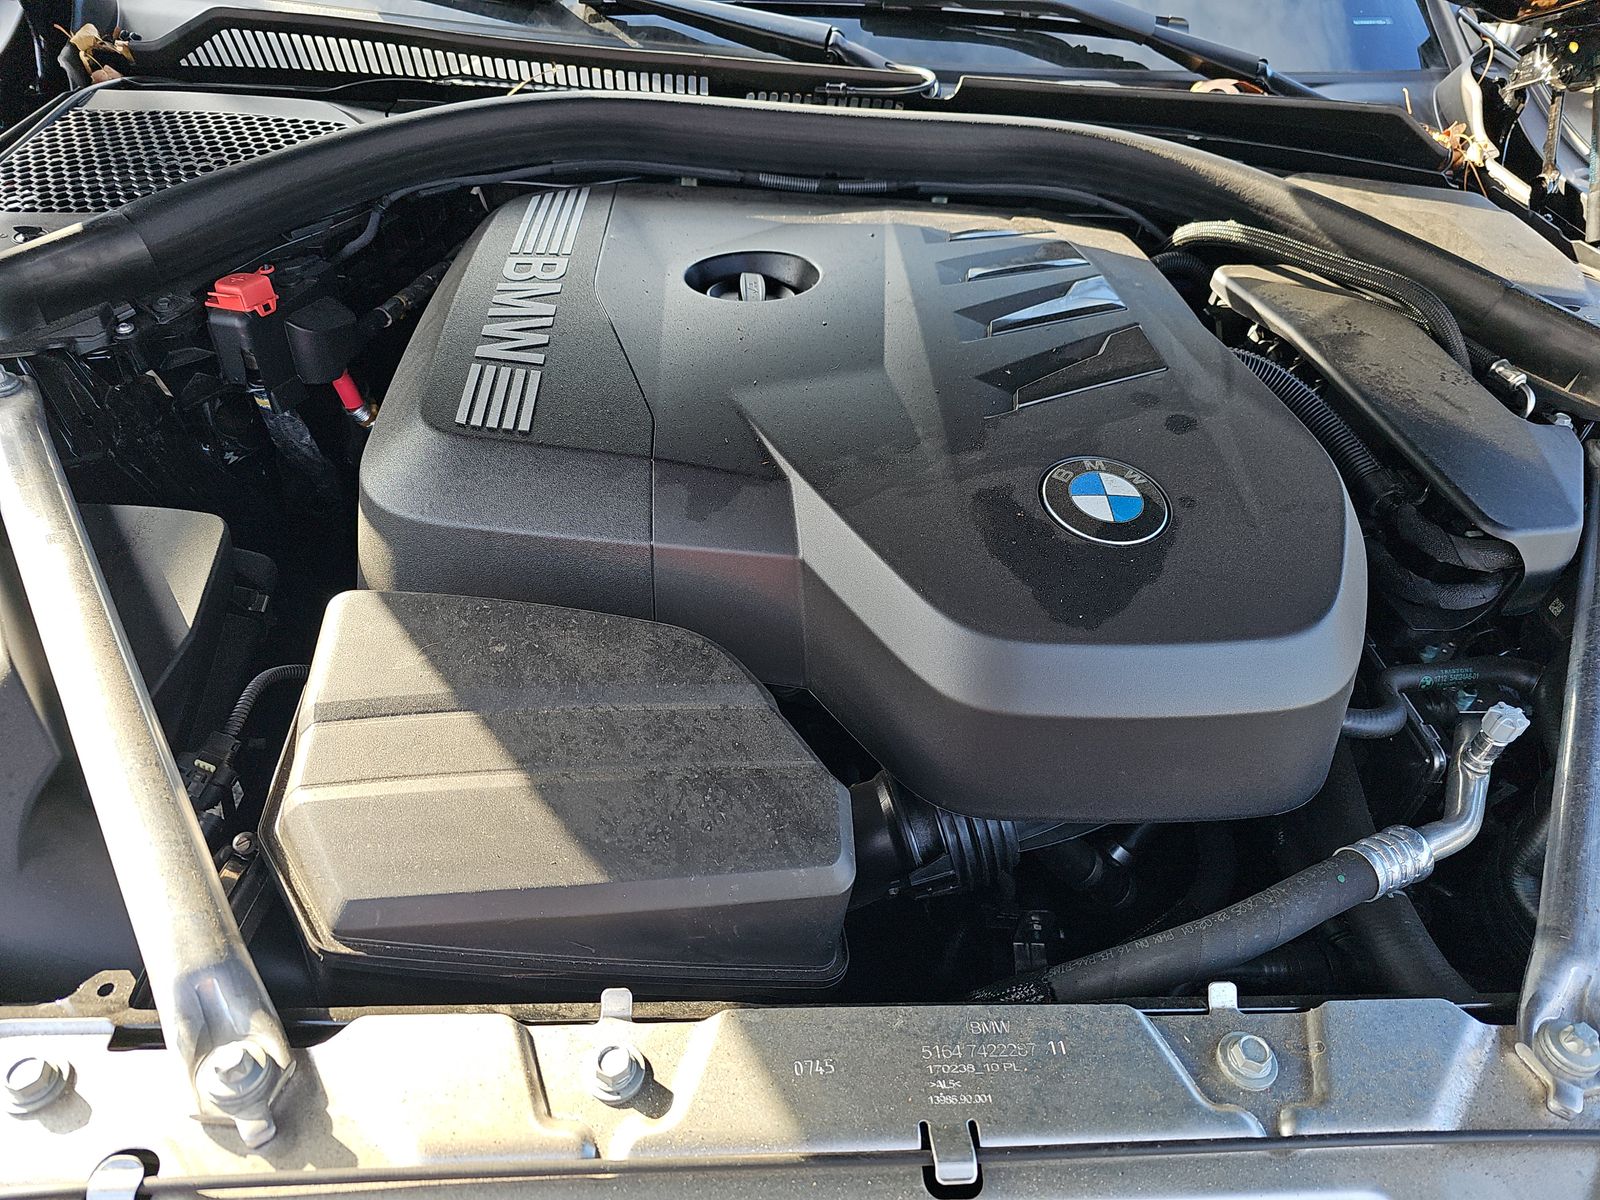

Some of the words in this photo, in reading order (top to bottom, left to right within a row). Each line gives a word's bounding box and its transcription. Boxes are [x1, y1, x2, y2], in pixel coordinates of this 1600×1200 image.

[475, 257, 569, 365] BMW
[1051, 459, 1148, 485] BMW
[968, 1019, 1010, 1035] BMW
[920, 1043, 963, 1060] 5164
[1047, 1040, 1067, 1056] 11
[793, 1058, 836, 1076] 0745
